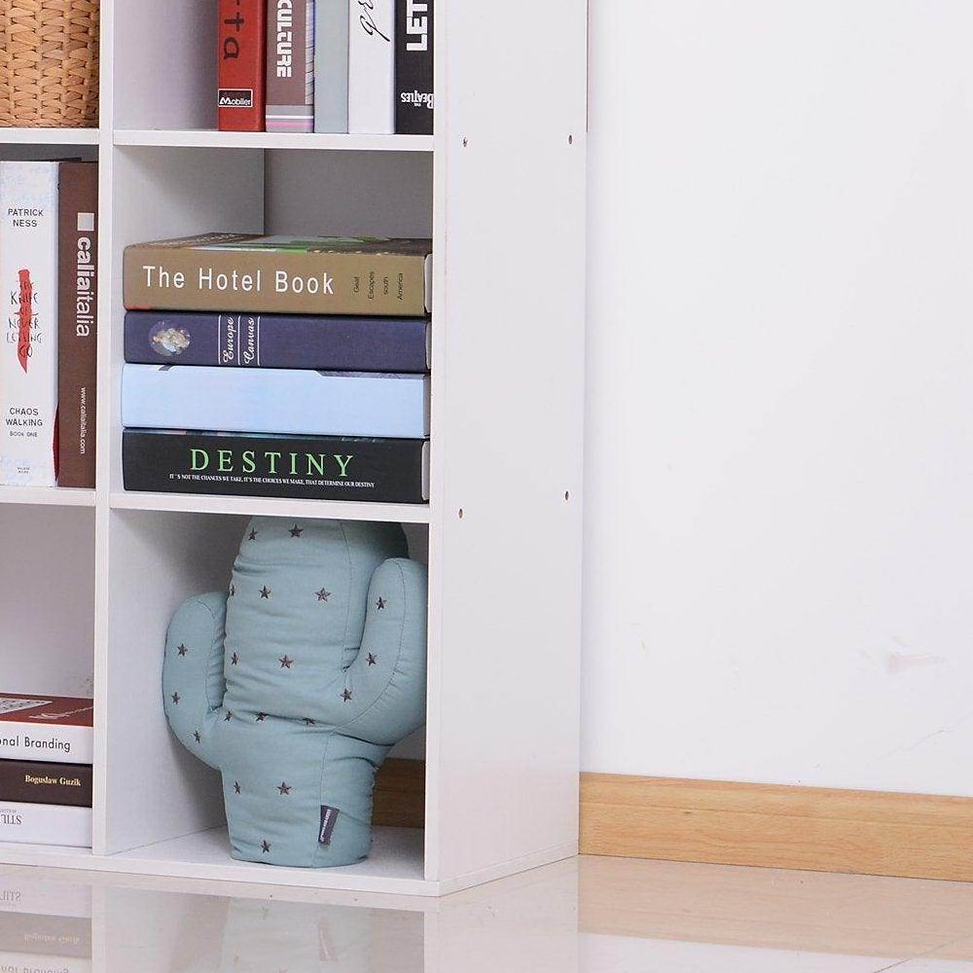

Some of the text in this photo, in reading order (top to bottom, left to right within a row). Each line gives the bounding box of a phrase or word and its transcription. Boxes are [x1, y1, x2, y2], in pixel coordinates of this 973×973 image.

[400, 90, 435, 109] BEATLES
[8, 208, 44, 218] PATRICK
[13, 219, 37, 228] NESS
[76, 237, 95, 337] caliaitalia
[143, 265, 334, 294] The Hotel Book
[222, 316, 237, 363] Europe
[243, 317, 255, 364] Canvas
[9, 407, 39, 416] CHAOS
[5, 417, 43, 427] WALKING
[190, 448, 354, 477] DESTINY
[24, 737, 70, 752] Branding
[59, 777, 81, 786] Guzik
